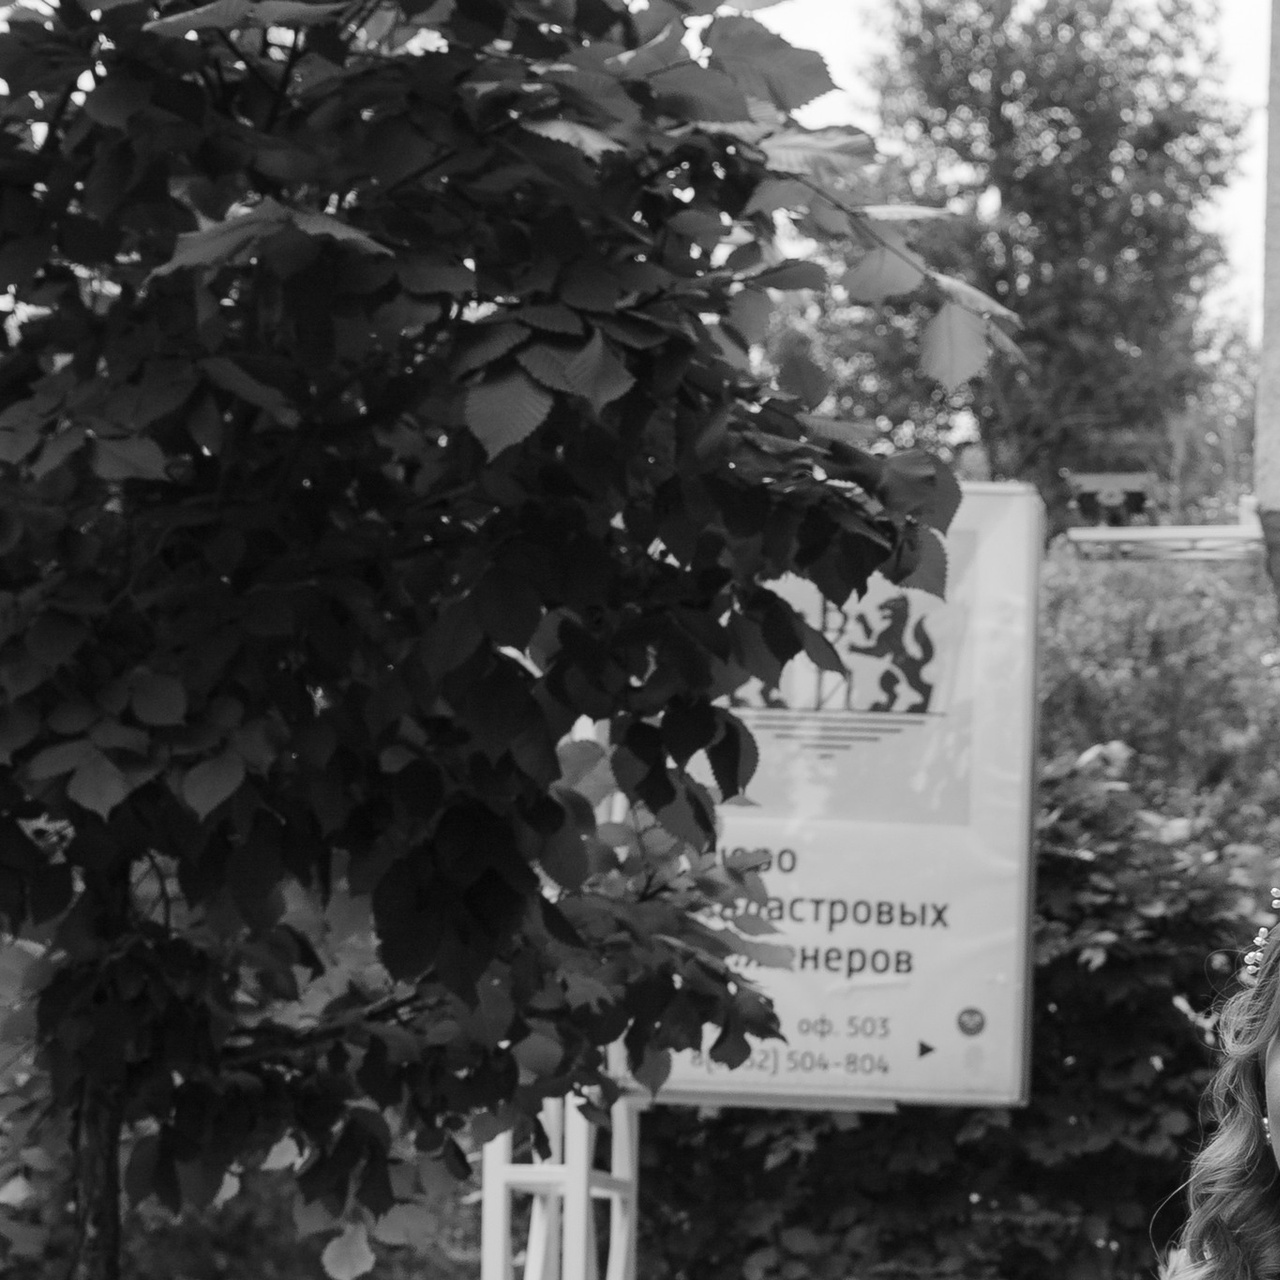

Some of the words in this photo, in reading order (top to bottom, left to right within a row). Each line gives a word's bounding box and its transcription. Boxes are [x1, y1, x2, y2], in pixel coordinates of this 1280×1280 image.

[799, 947, 914, 978] неров
[847, 1016, 891, 1038] 503
[786, 1051, 890, 1074] 504-804
